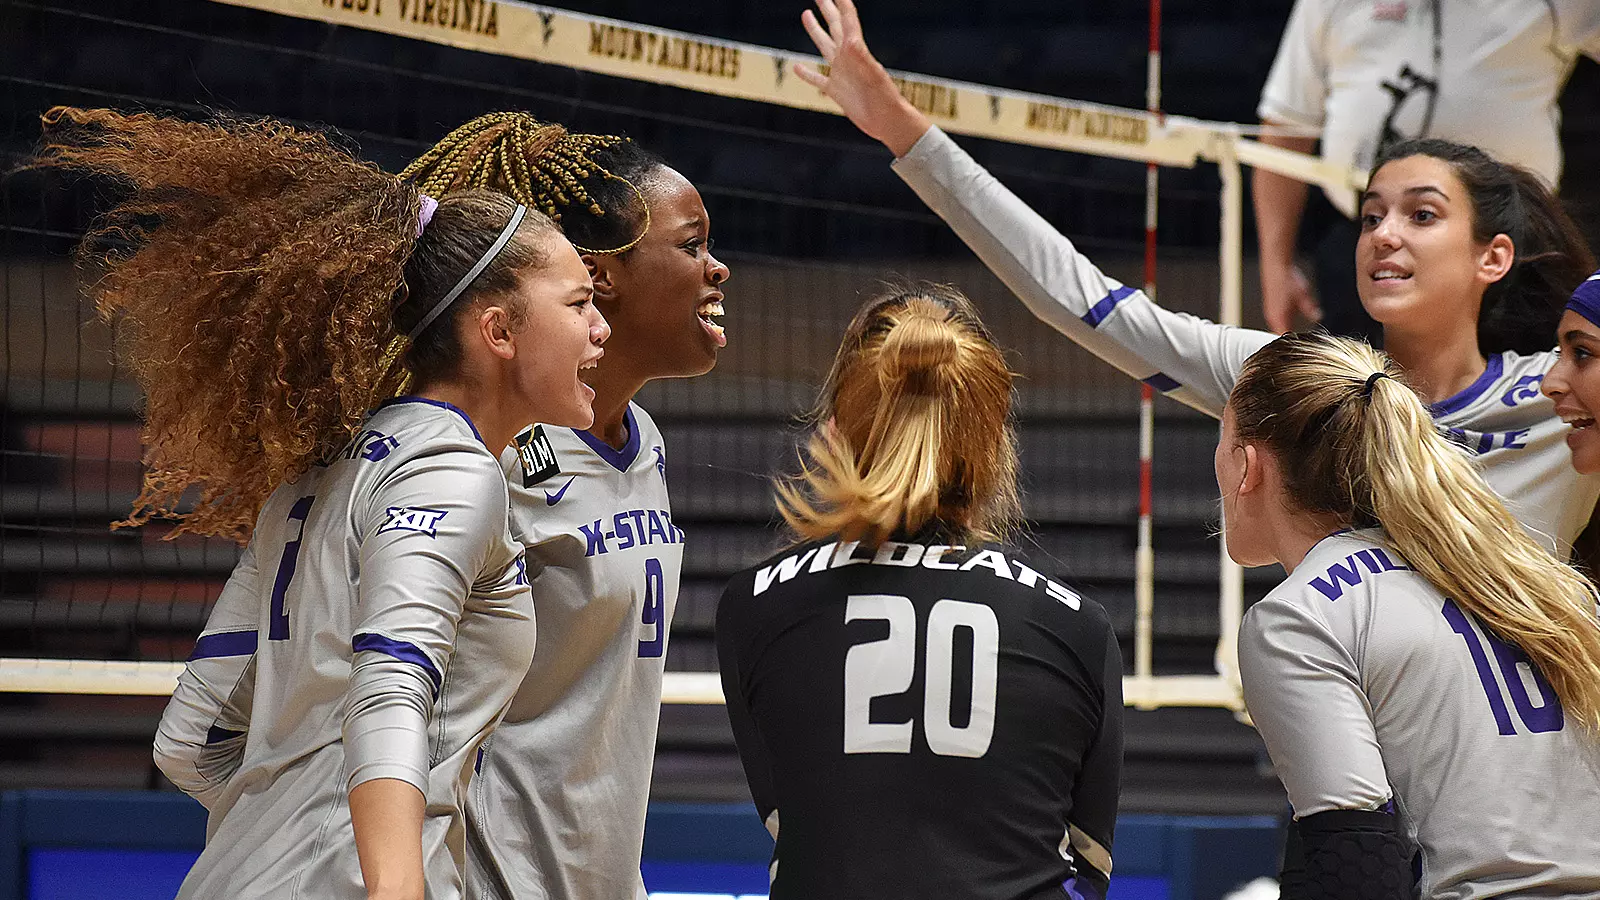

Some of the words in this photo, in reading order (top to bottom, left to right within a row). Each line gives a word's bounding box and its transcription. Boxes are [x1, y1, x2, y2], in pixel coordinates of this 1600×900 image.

[589, 21, 740, 79] MOUNTAINEERS
[519, 435, 555, 477] BLM
[577, 509, 686, 557] K-STAT
[753, 540, 1083, 612] WILDCATS
[1307, 548, 1414, 602] WIL
[638, 558, 665, 658] 9
[844, 594, 999, 758] 20
[1441, 598, 1564, 736] 16
